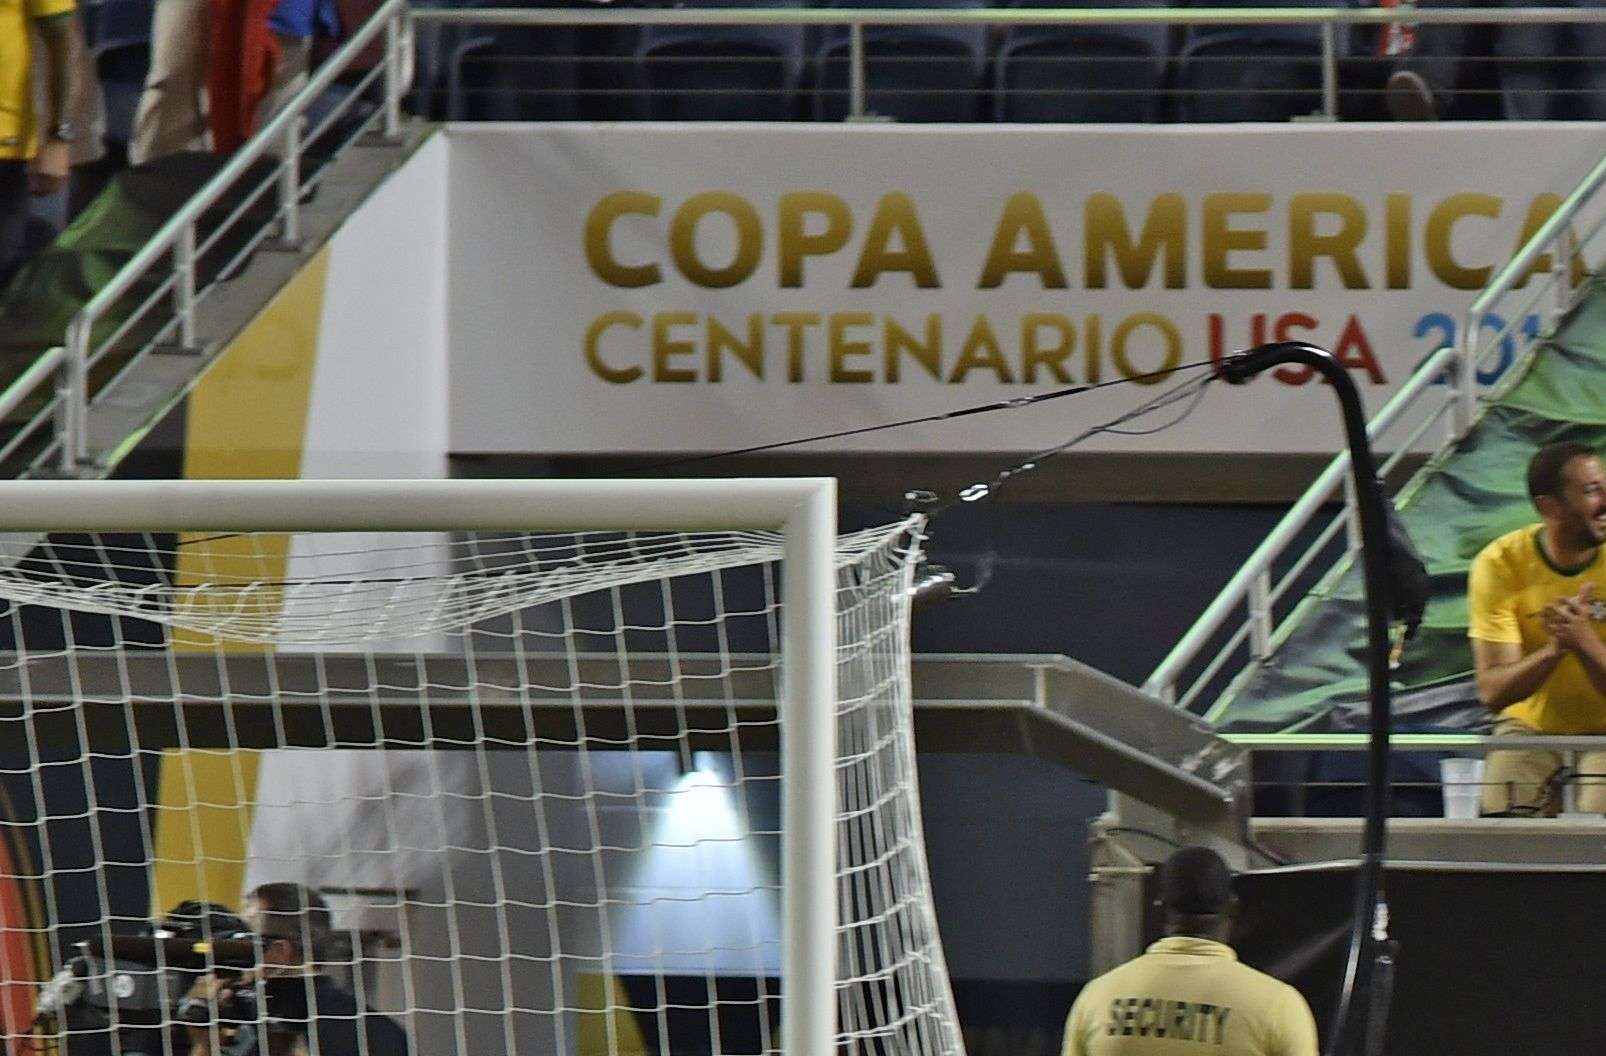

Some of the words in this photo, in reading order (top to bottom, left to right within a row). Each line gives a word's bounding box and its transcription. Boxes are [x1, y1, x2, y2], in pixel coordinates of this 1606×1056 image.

[584, 191, 937, 290] COPA
[978, 191, 1587, 290] AMERICA
[584, 311, 1183, 385] CENTENARIO
[1208, 312, 1388, 386] USA
[1108, 998, 1232, 1045] SECURITY
